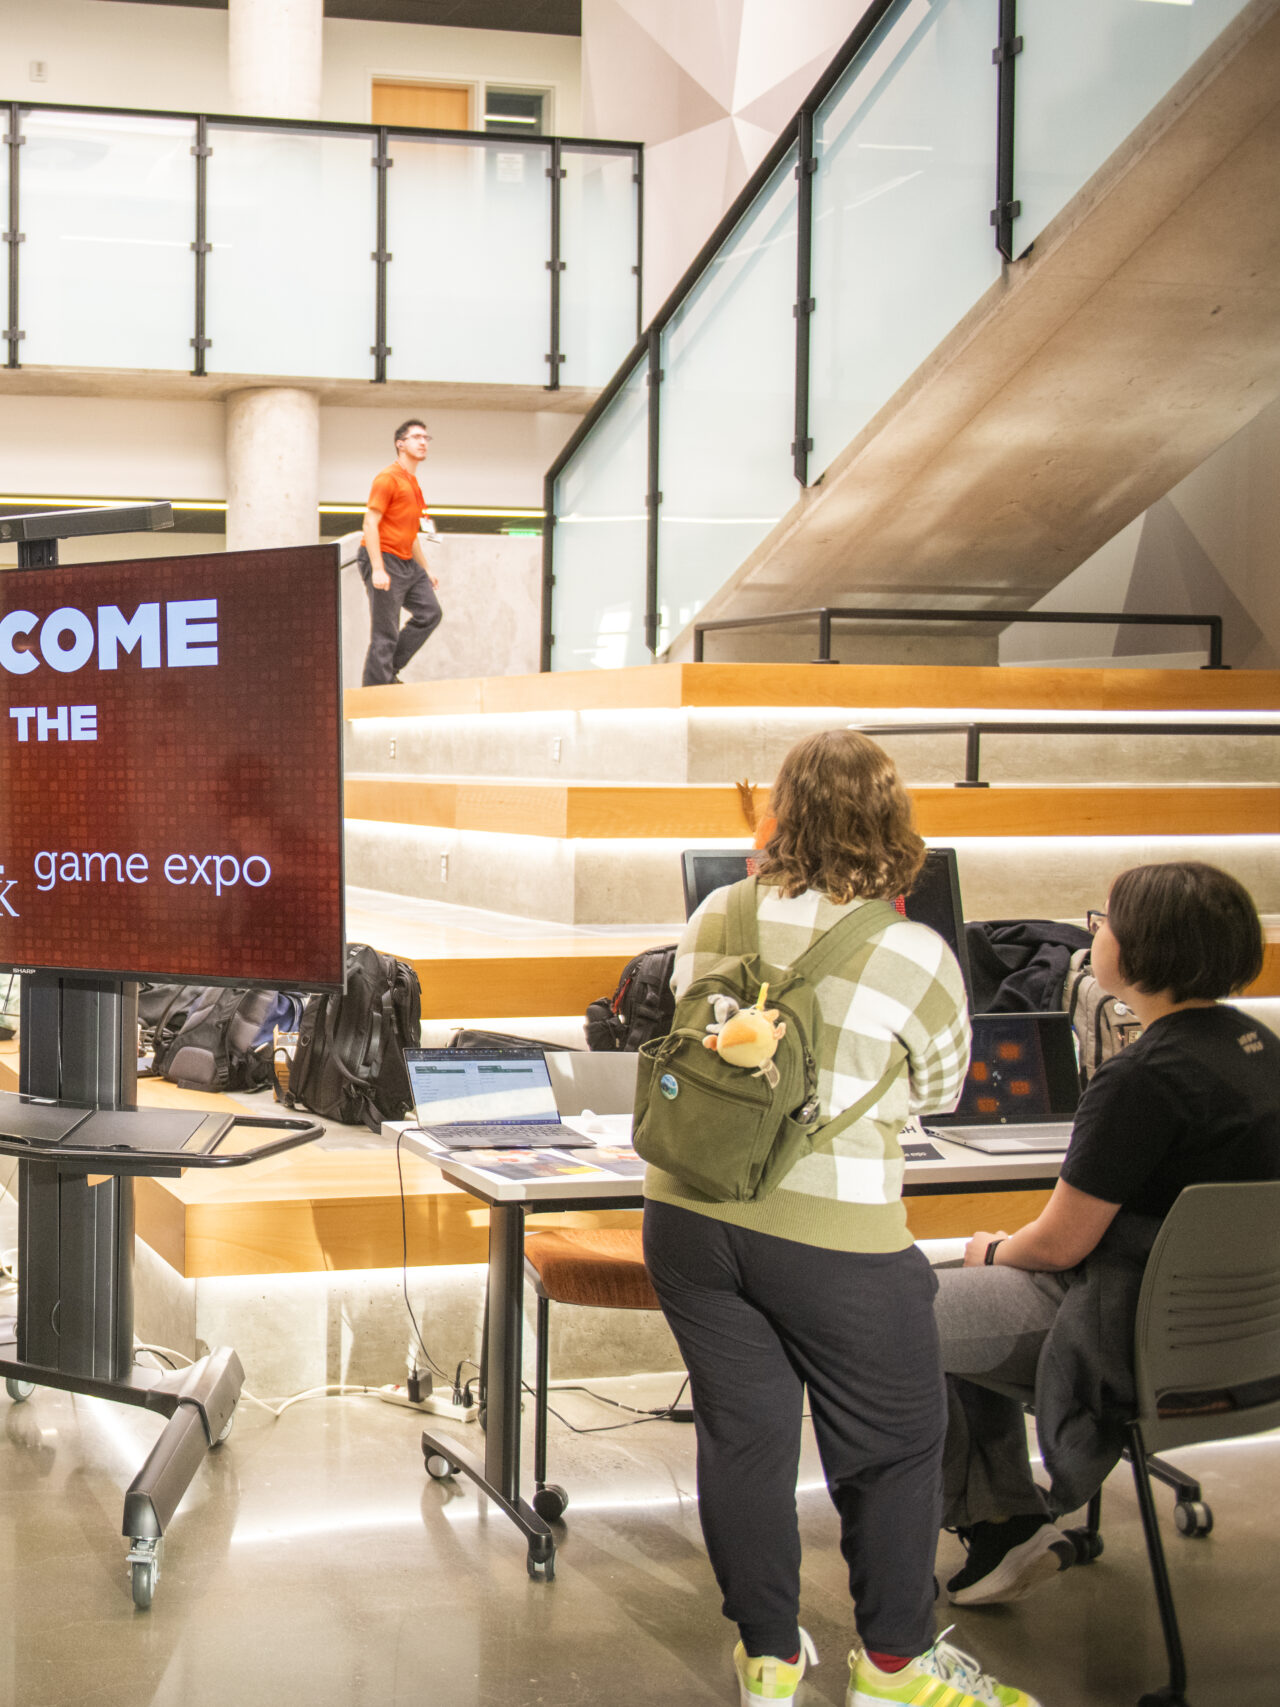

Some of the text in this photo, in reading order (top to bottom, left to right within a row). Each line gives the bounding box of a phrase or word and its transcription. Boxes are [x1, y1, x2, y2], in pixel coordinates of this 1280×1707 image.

[9, 705, 98, 742] THE
[34, 850, 272, 896] game expo
